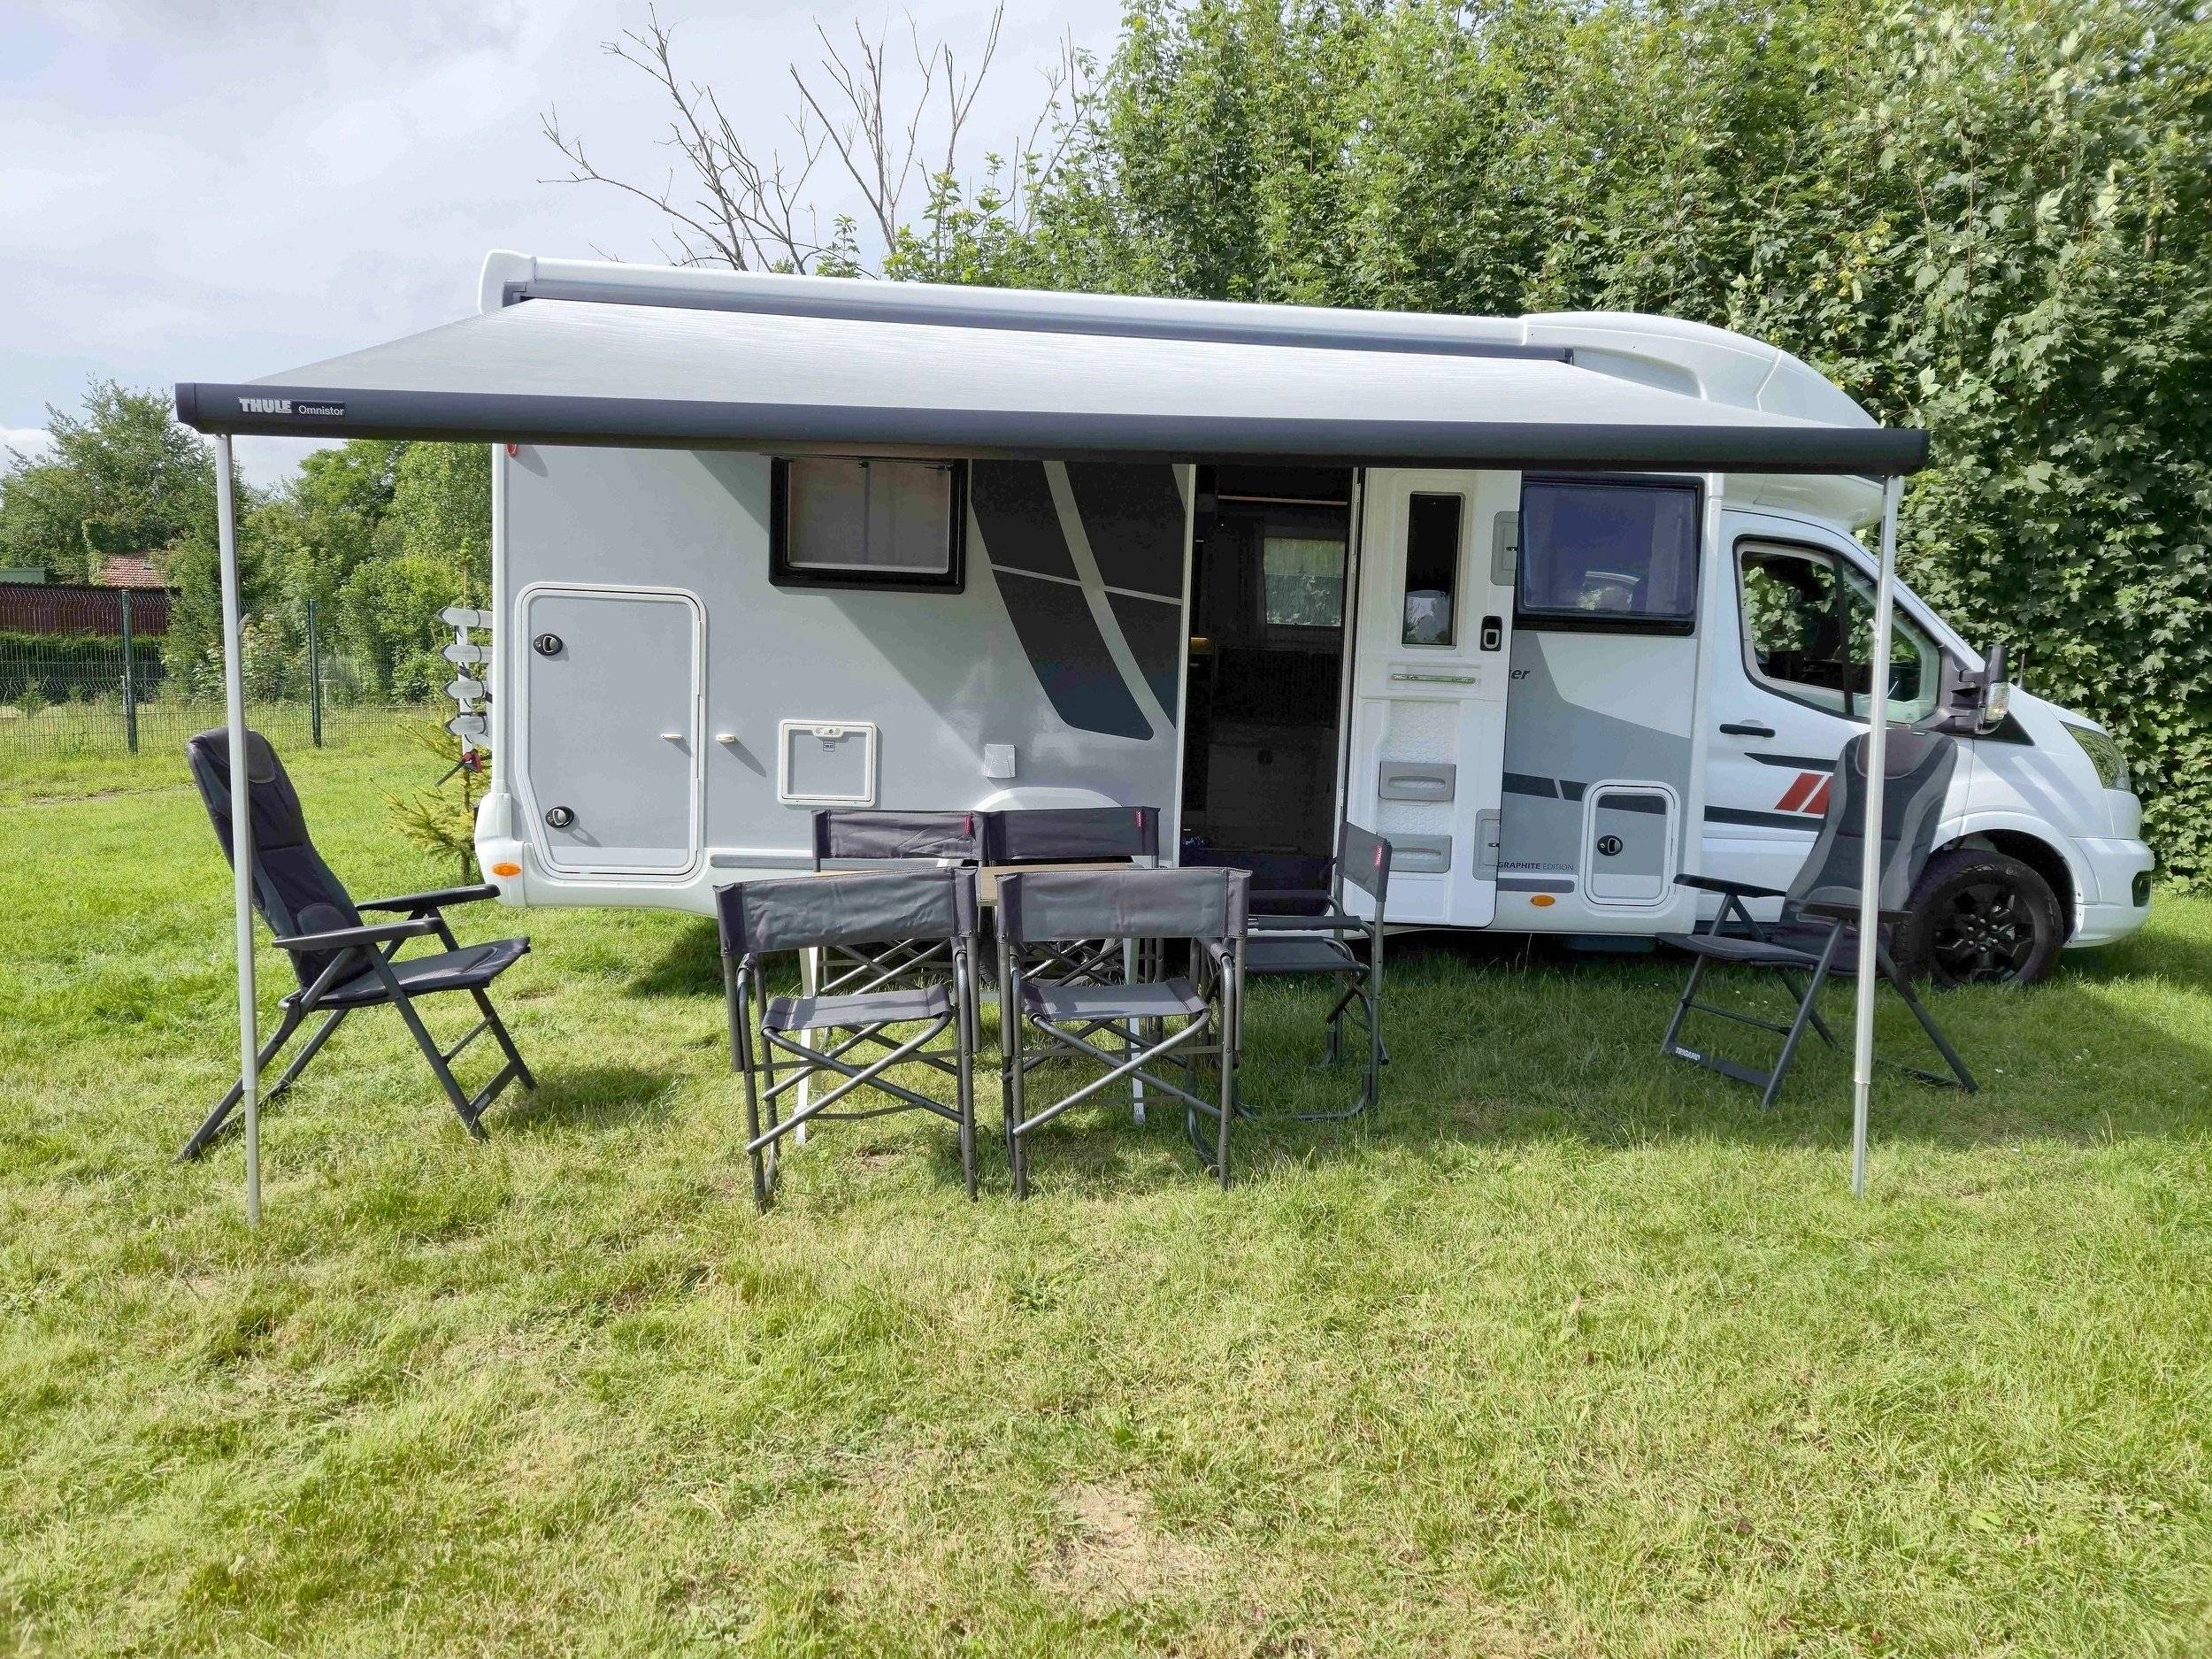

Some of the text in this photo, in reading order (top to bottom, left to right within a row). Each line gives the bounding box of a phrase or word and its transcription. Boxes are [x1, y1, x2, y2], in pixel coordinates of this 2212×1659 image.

[239, 398, 344, 416] THULE Omnistor
[1510, 669, 1531, 680] er
[1498, 861, 1540, 870] GRAPHITE
